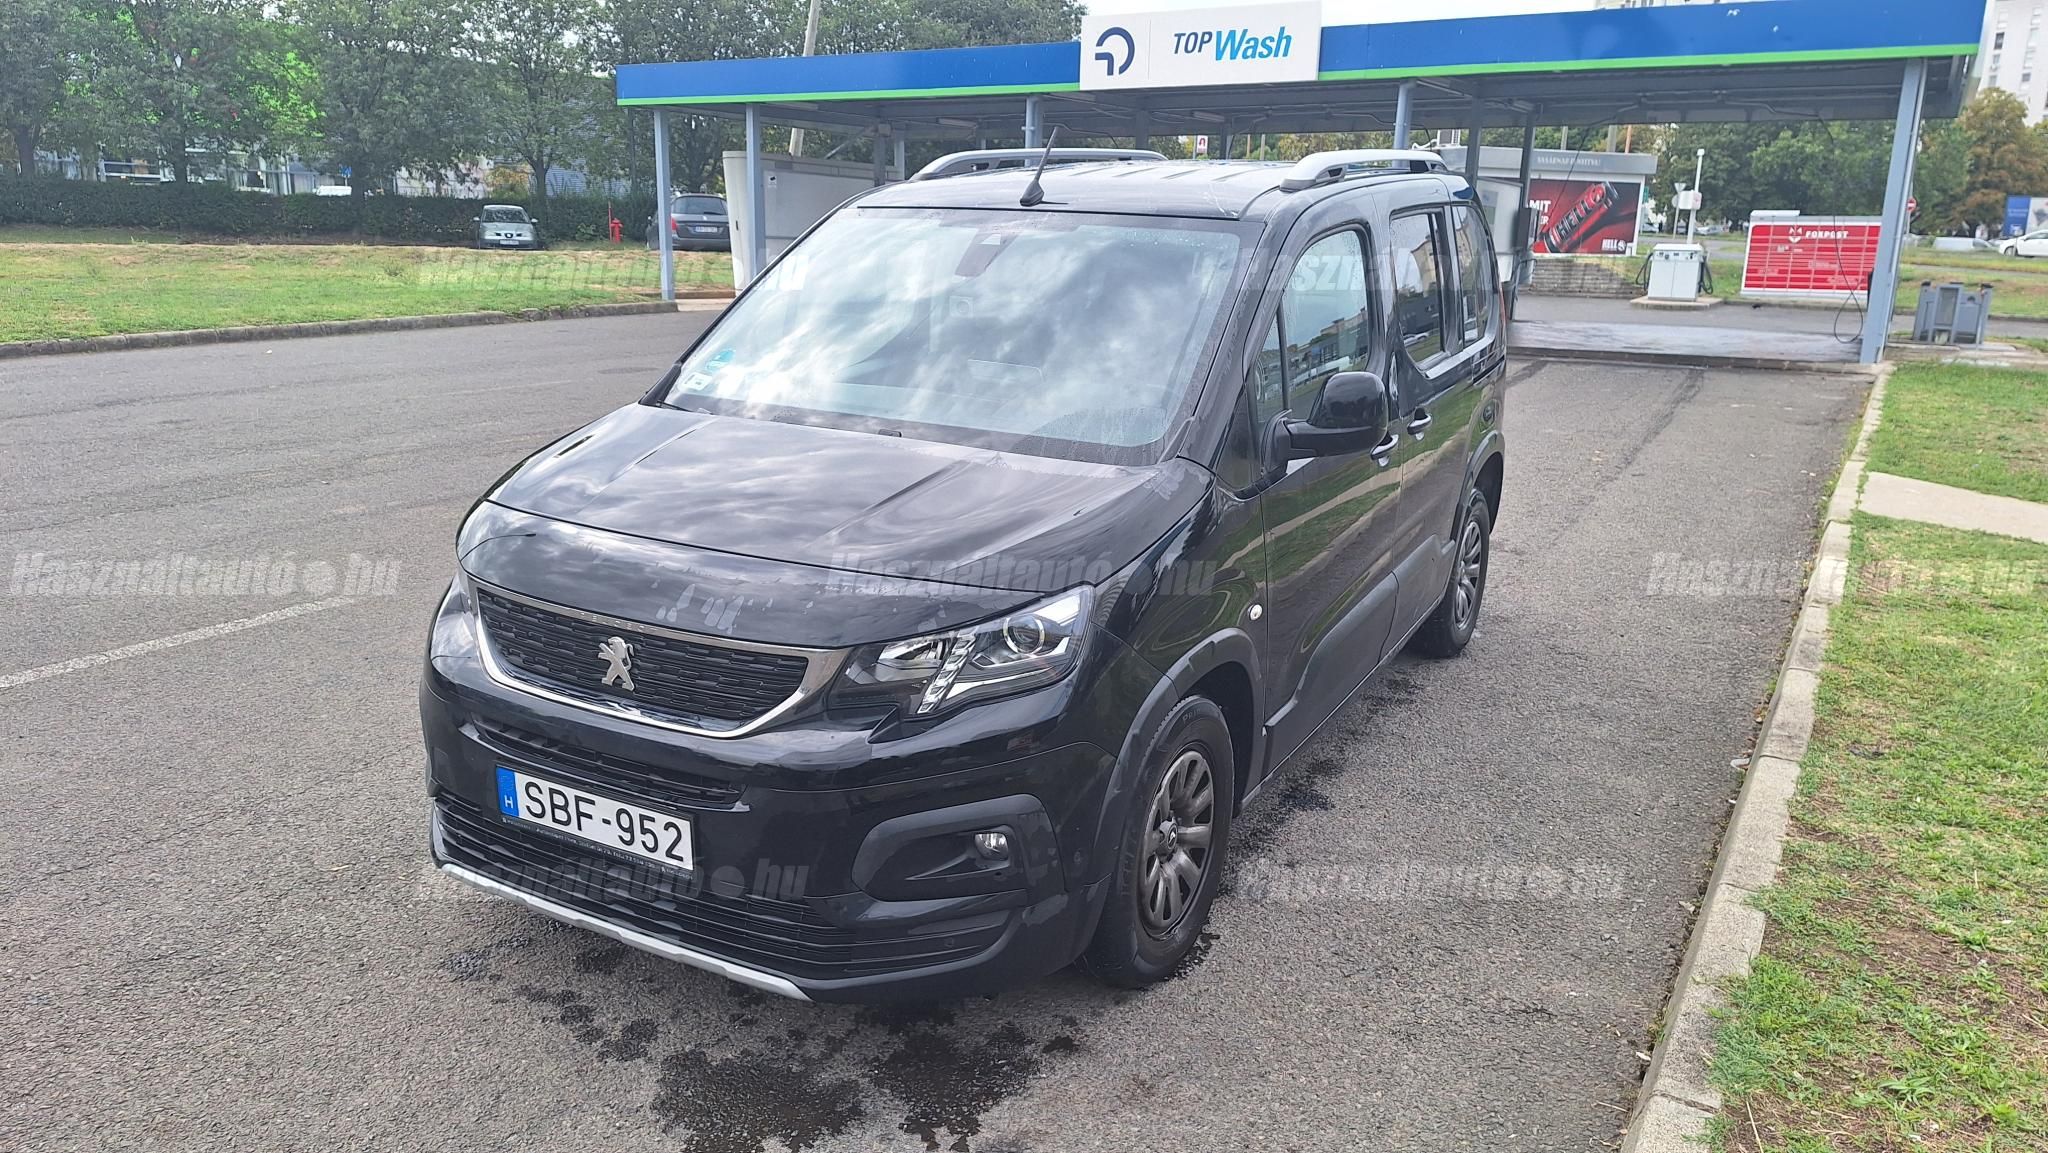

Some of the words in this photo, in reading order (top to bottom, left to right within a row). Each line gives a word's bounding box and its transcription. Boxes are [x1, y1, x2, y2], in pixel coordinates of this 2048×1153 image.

[1805, 230, 1849, 239] FOXPOST
[504, 795, 513, 809] H
[524, 781, 684, 862] SBF-952
